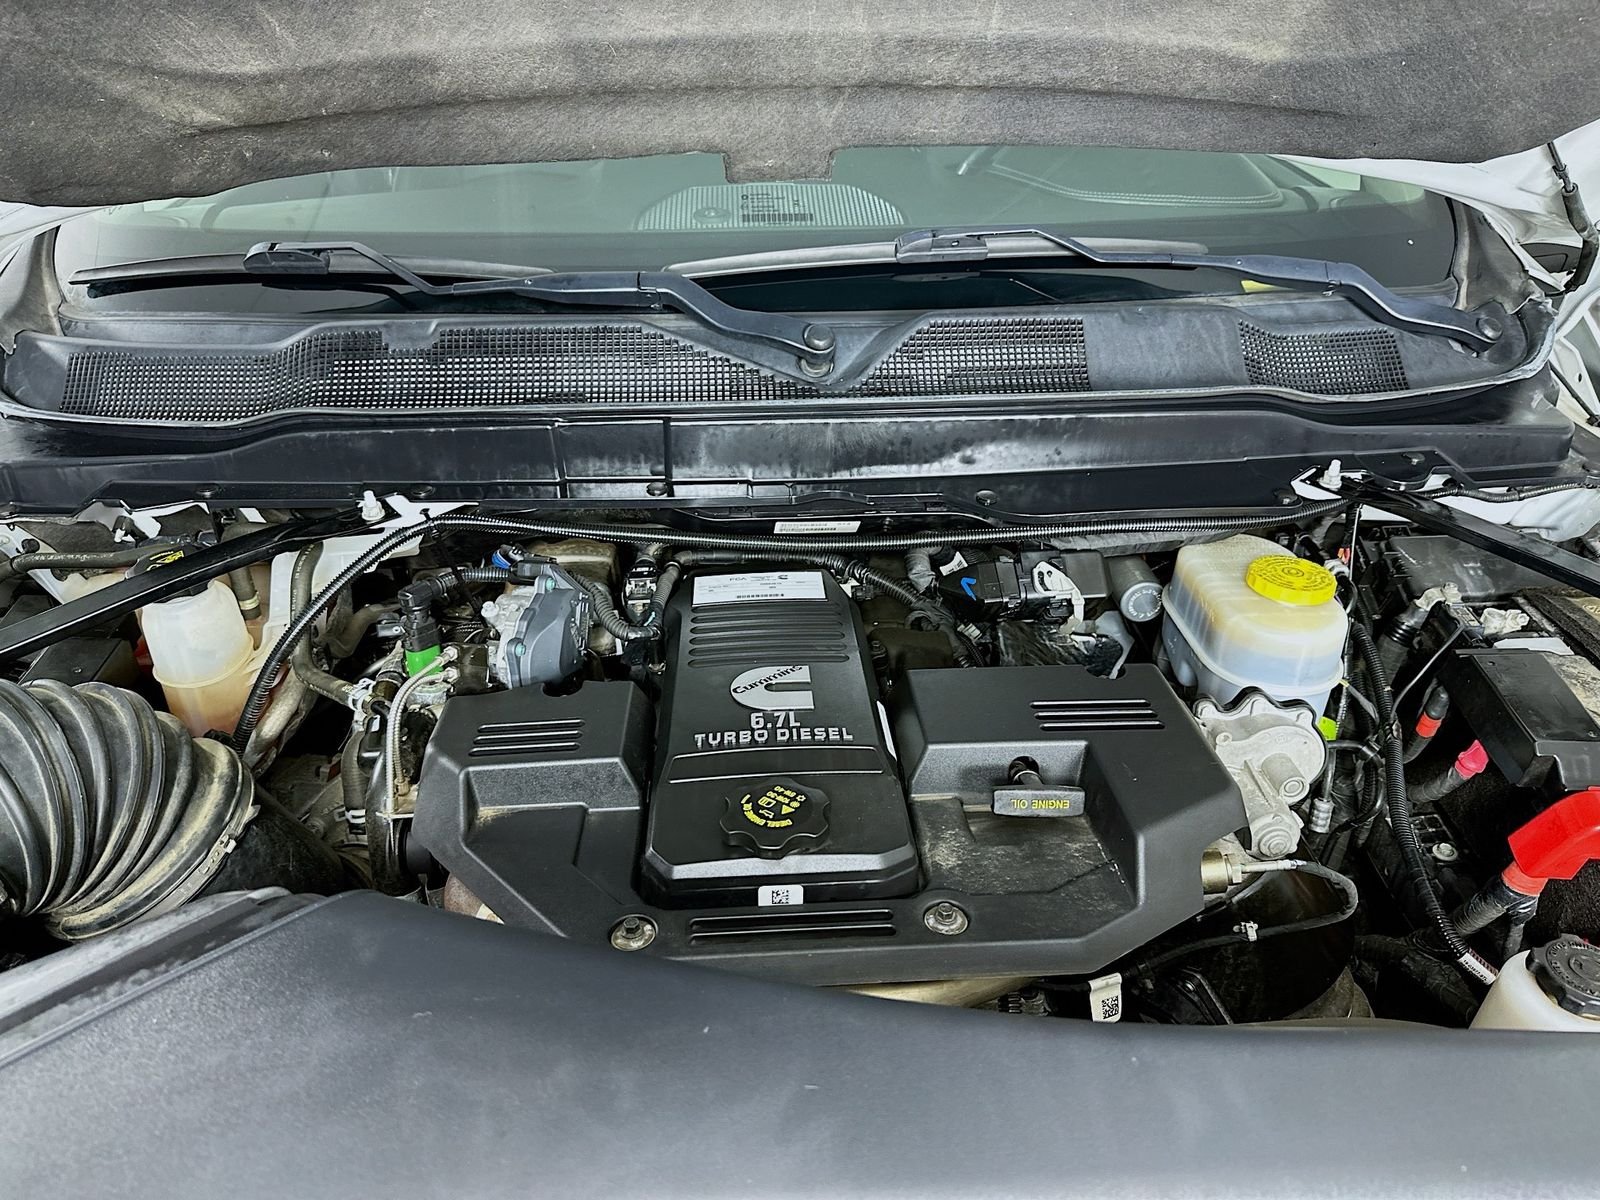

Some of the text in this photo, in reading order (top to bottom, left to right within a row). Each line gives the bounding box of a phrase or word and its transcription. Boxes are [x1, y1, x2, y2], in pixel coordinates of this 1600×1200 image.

[732, 665, 803, 694] Cummins
[750, 711, 801, 729] 6.7L
[694, 727, 854, 747] TURBO DIESEL
[1010, 799, 1070, 809] ENGINE OIL
